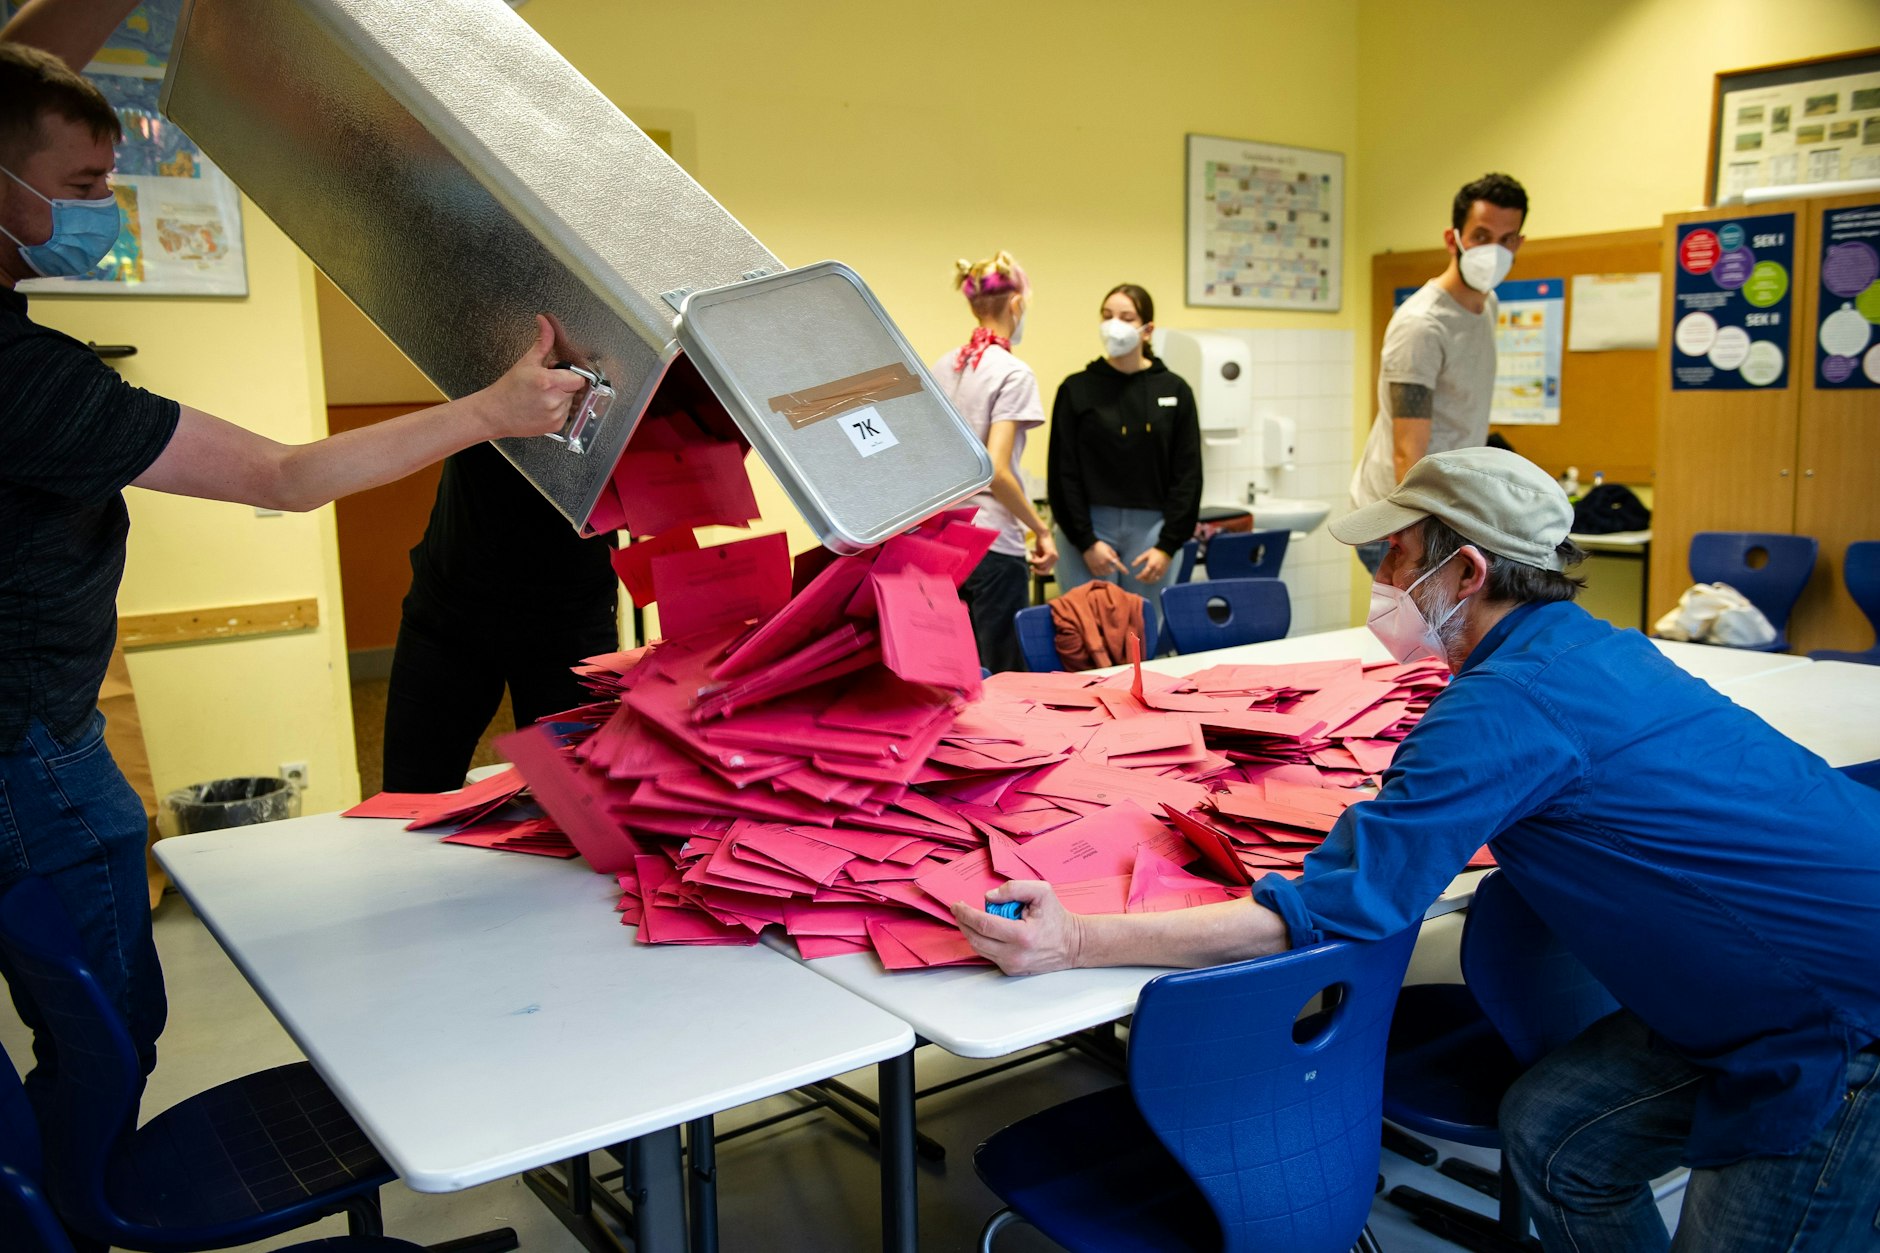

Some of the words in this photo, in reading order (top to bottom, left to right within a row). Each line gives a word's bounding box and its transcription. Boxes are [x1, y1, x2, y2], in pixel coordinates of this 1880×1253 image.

[1752, 234, 1777, 248] SEK
[1745, 313, 1769, 327] SEK
[852, 418, 881, 440] 7K
